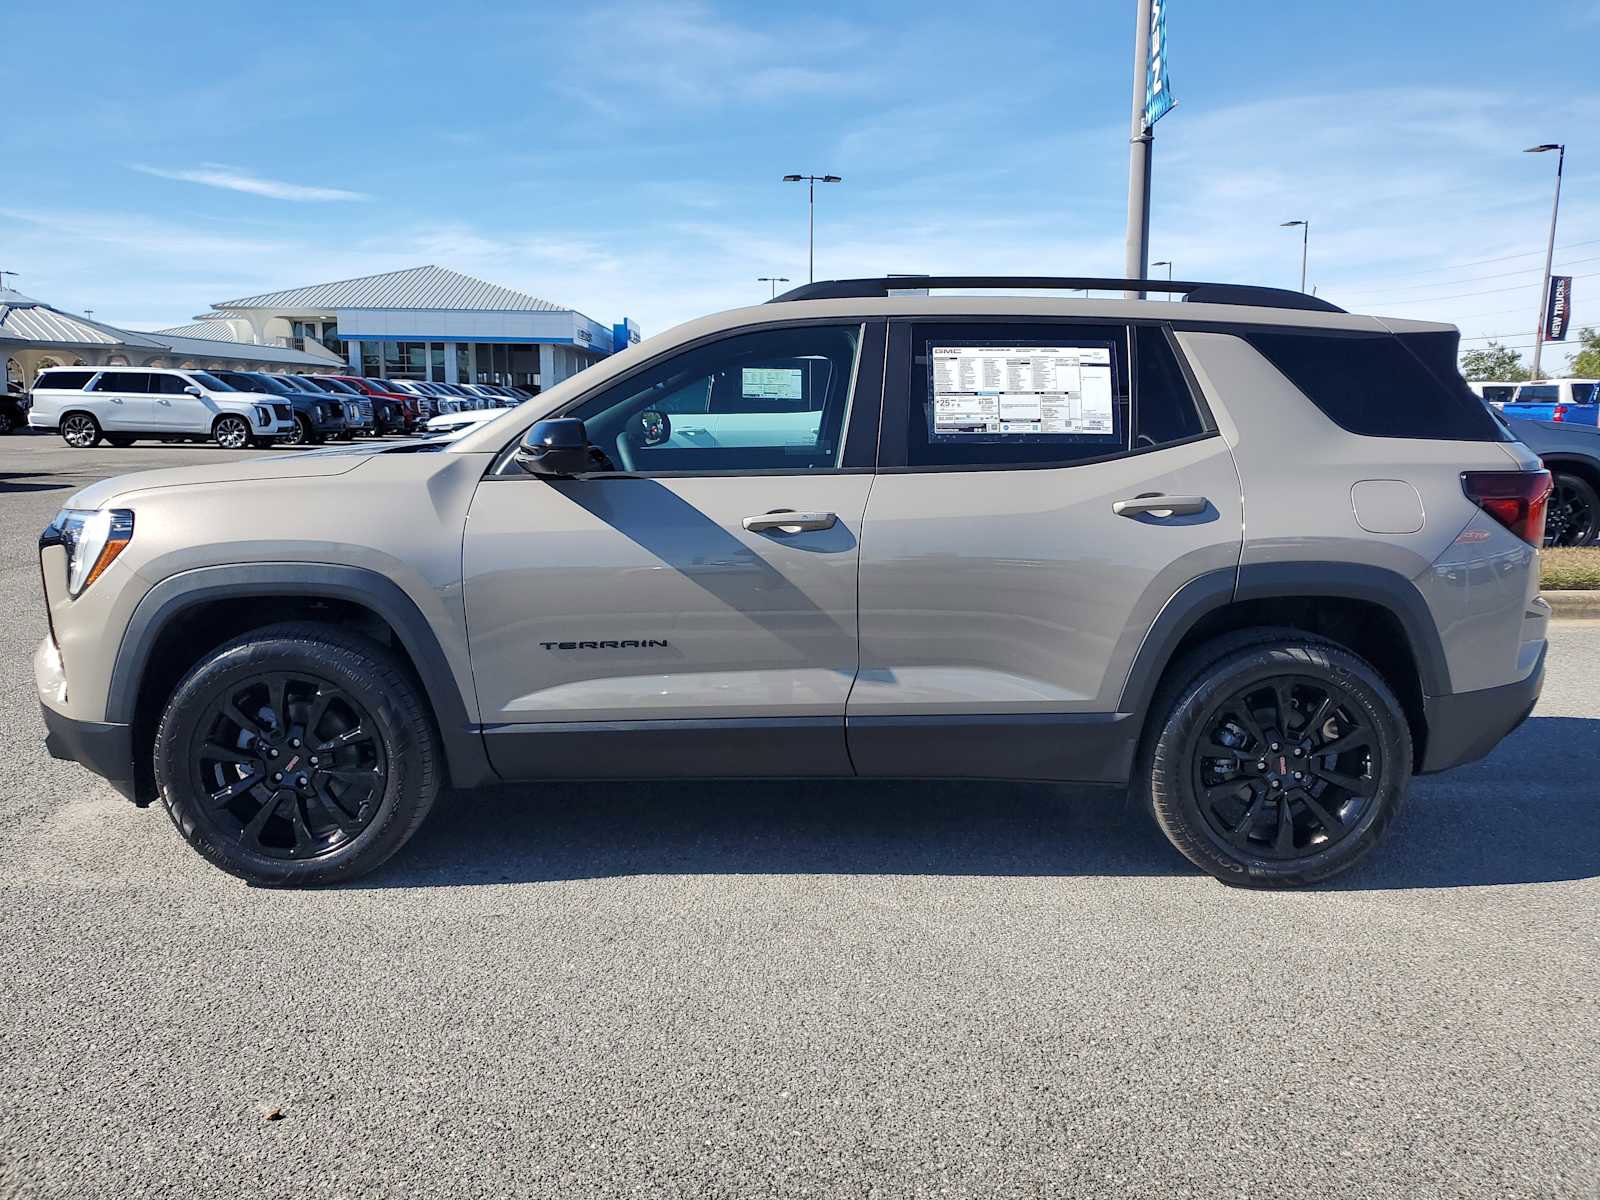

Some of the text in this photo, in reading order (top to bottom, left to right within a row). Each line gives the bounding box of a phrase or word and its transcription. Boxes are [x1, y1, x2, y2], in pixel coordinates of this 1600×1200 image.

[1551, 279, 1565, 338] NEW TRUCKS
[538, 639, 668, 650] TERRAIN
